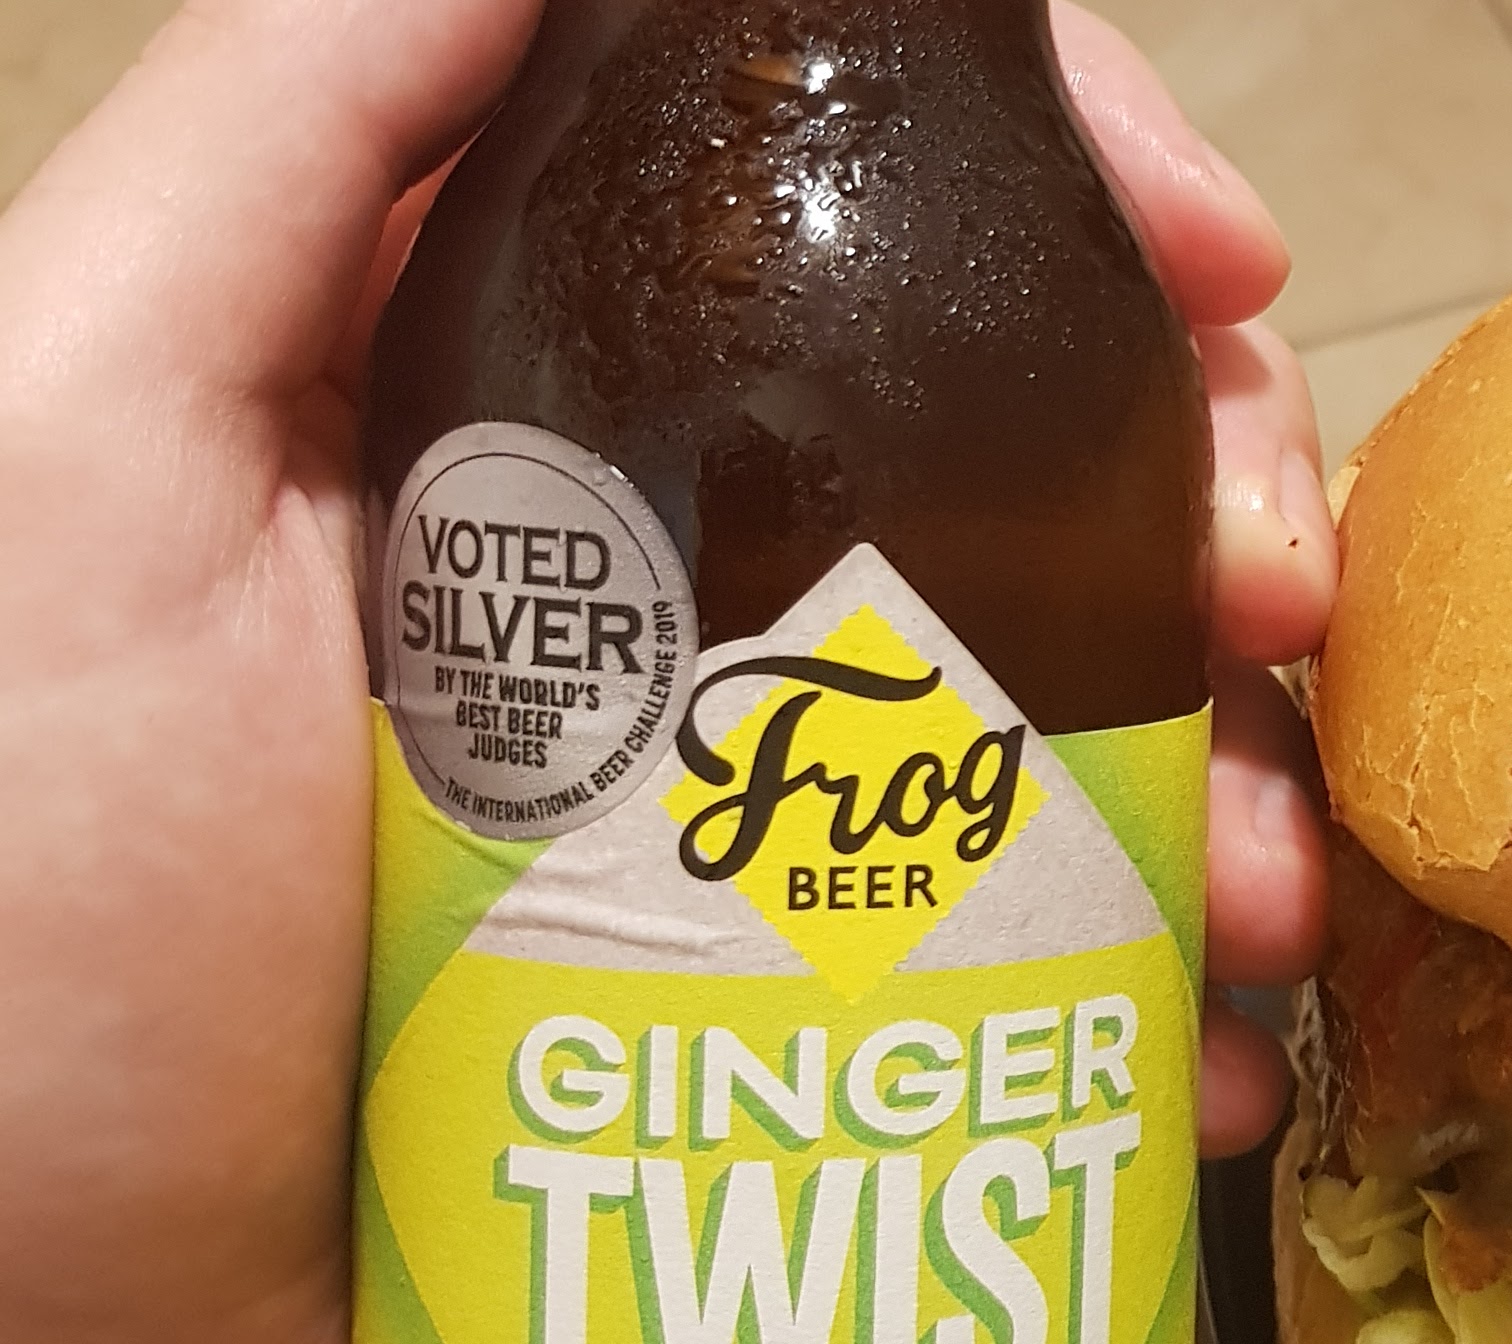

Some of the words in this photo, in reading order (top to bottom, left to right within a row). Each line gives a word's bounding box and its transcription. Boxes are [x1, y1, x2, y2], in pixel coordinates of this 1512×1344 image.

[418, 515, 611, 591] VOTED
[402, 580, 645, 674] SILVER
[434, 666, 457, 693] BY
[459, 670, 492, 699] THE
[499, 677, 600, 711] WORLD'S
[445, 776, 471, 809] THE
[472, 781, 595, 822] INTERNATIONAL
[590, 749, 634, 792] BEER
[624, 649, 677, 753] CHALLENGE
[652, 601, 678, 645] 2019
[456, 700, 501, 730] BEST
[507, 708, 562, 739] BEER
[468, 734, 548, 768] JUDGES
[676, 656, 1026, 881] Frog
[788, 864, 938, 911] BEER
[508, 994, 1137, 1151] GINGER
